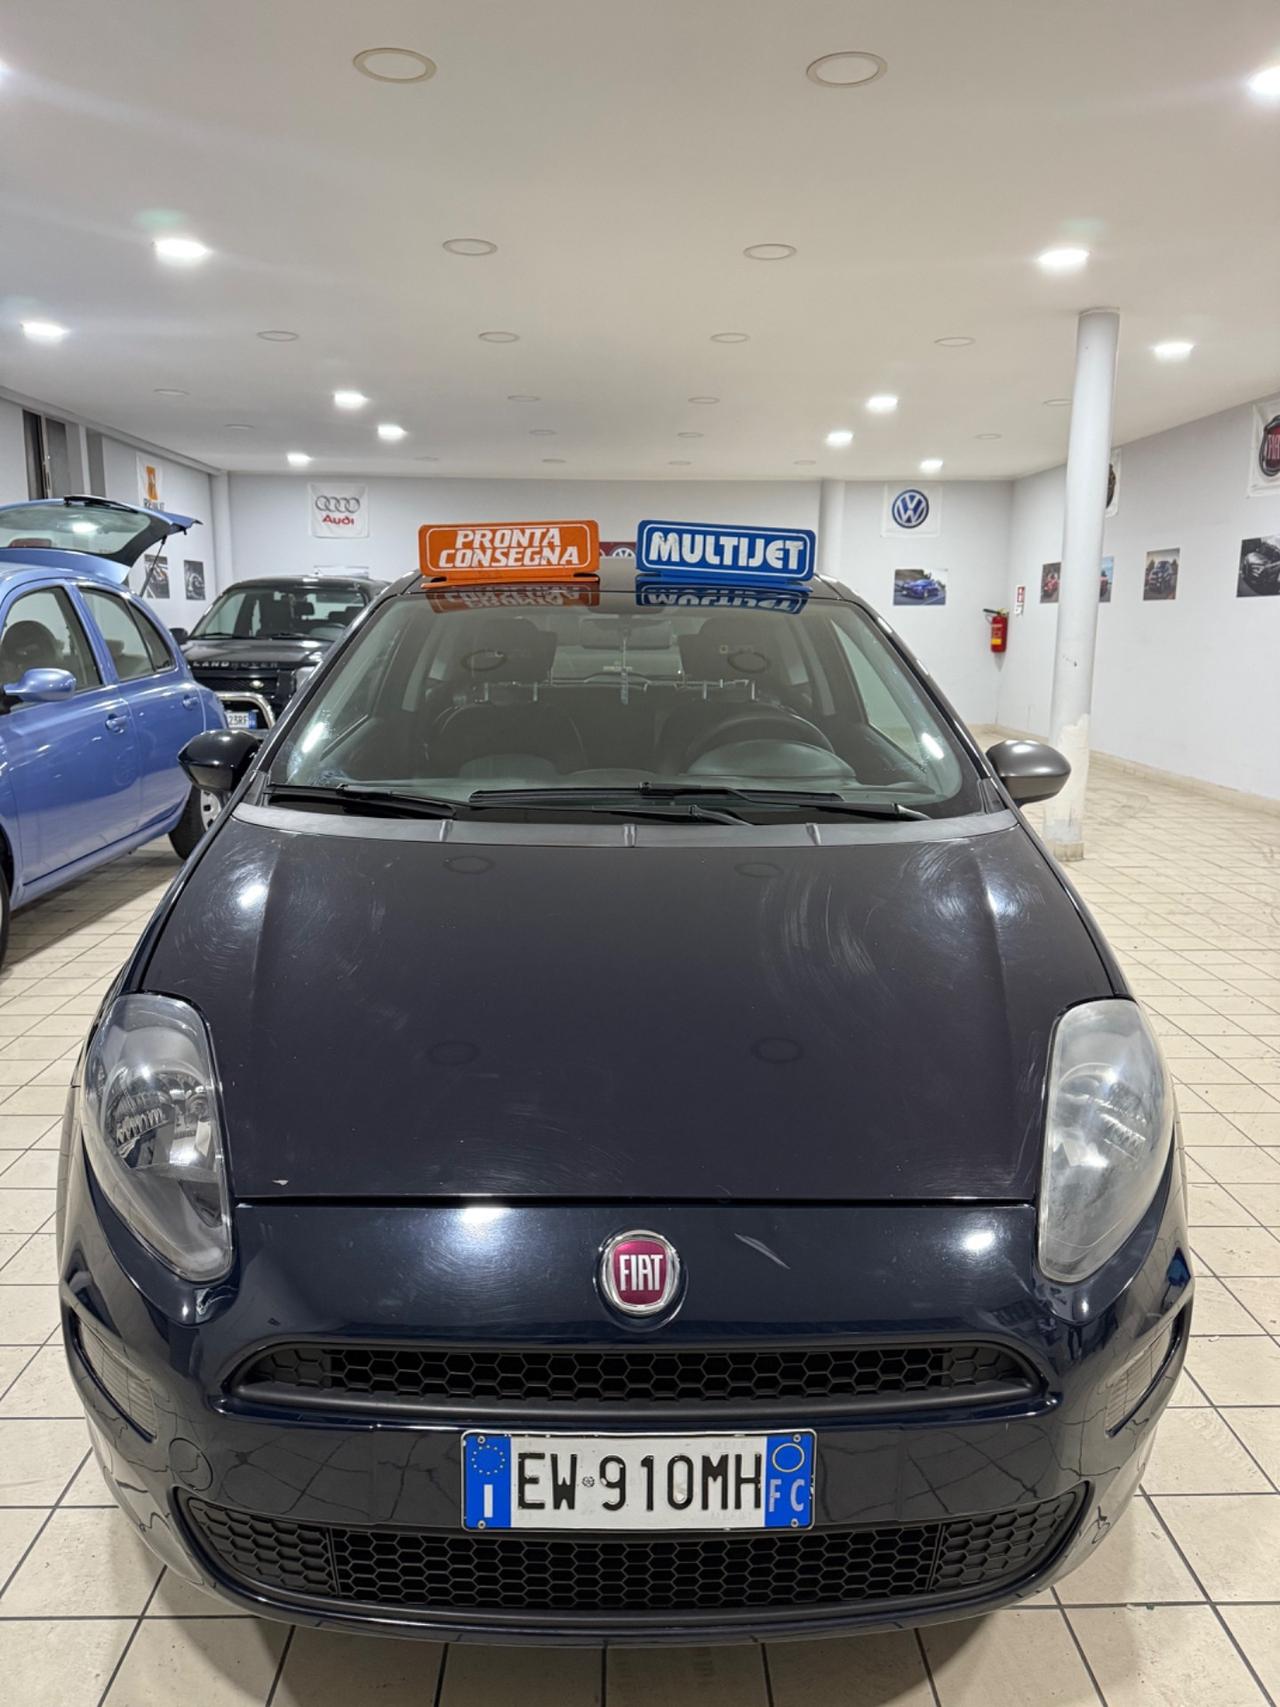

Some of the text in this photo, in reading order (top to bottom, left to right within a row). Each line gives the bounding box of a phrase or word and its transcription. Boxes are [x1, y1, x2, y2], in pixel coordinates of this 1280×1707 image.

[322, 514, 354, 526] Audi
[894, 492, 927, 527] VW
[454, 527, 562, 549] PRONTA
[438, 545, 580, 569] CONSEGNA
[648, 531, 805, 570] MULTIJET
[192, 660, 230, 668] LAND
[618, 1253, 664, 1292] FIAT
